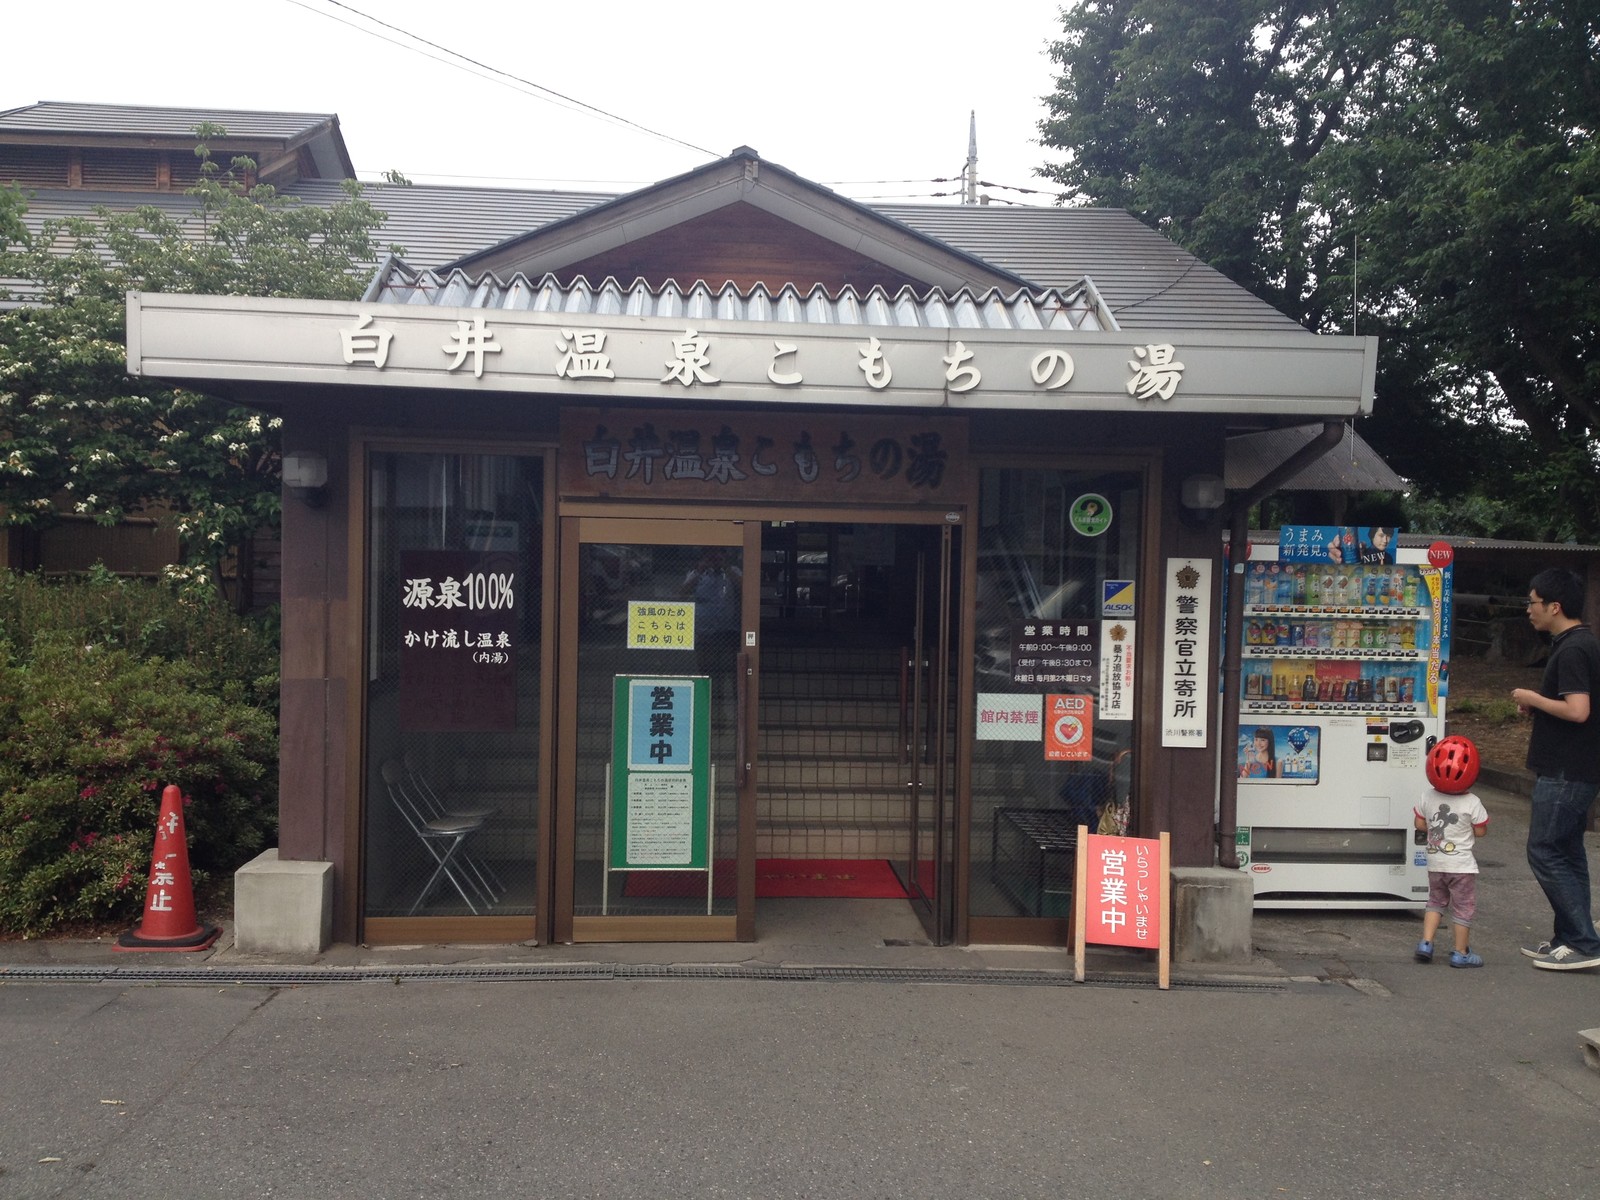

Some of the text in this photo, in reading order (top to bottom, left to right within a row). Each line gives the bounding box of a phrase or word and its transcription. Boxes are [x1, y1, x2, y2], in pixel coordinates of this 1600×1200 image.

[339, 314, 1185, 399] 白井温泉こもちの湯
[582, 422, 949, 489] 白井温泉こもちの湯
[1285, 528, 1323, 542] うまみ
[1283, 544, 1328, 557] 新発見。
[1363, 552, 1386, 564] NEW
[1430, 550, 1452, 559] NEW
[402, 572, 515, 611] 源泉100%
[637, 607, 686, 617] 強風のため
[638, 621, 686, 630] こちらは
[1024, 625, 1089, 636] 営業時間
[404, 628, 512, 649] かけ流し温泉
[636, 634, 685, 644] 閉め切り
[1173, 595, 1199, 719] 警察官立寄所
[1111, 644, 1123, 709] 暴力追放協力店
[1054, 698, 1086, 710] AED
[980, 709, 1039, 724] 館内禁煙
[650, 686, 675, 764] 営業中
[1100, 849, 1128, 934] 営業中
[1135, 845, 1149, 940] いらっしゃいませ
